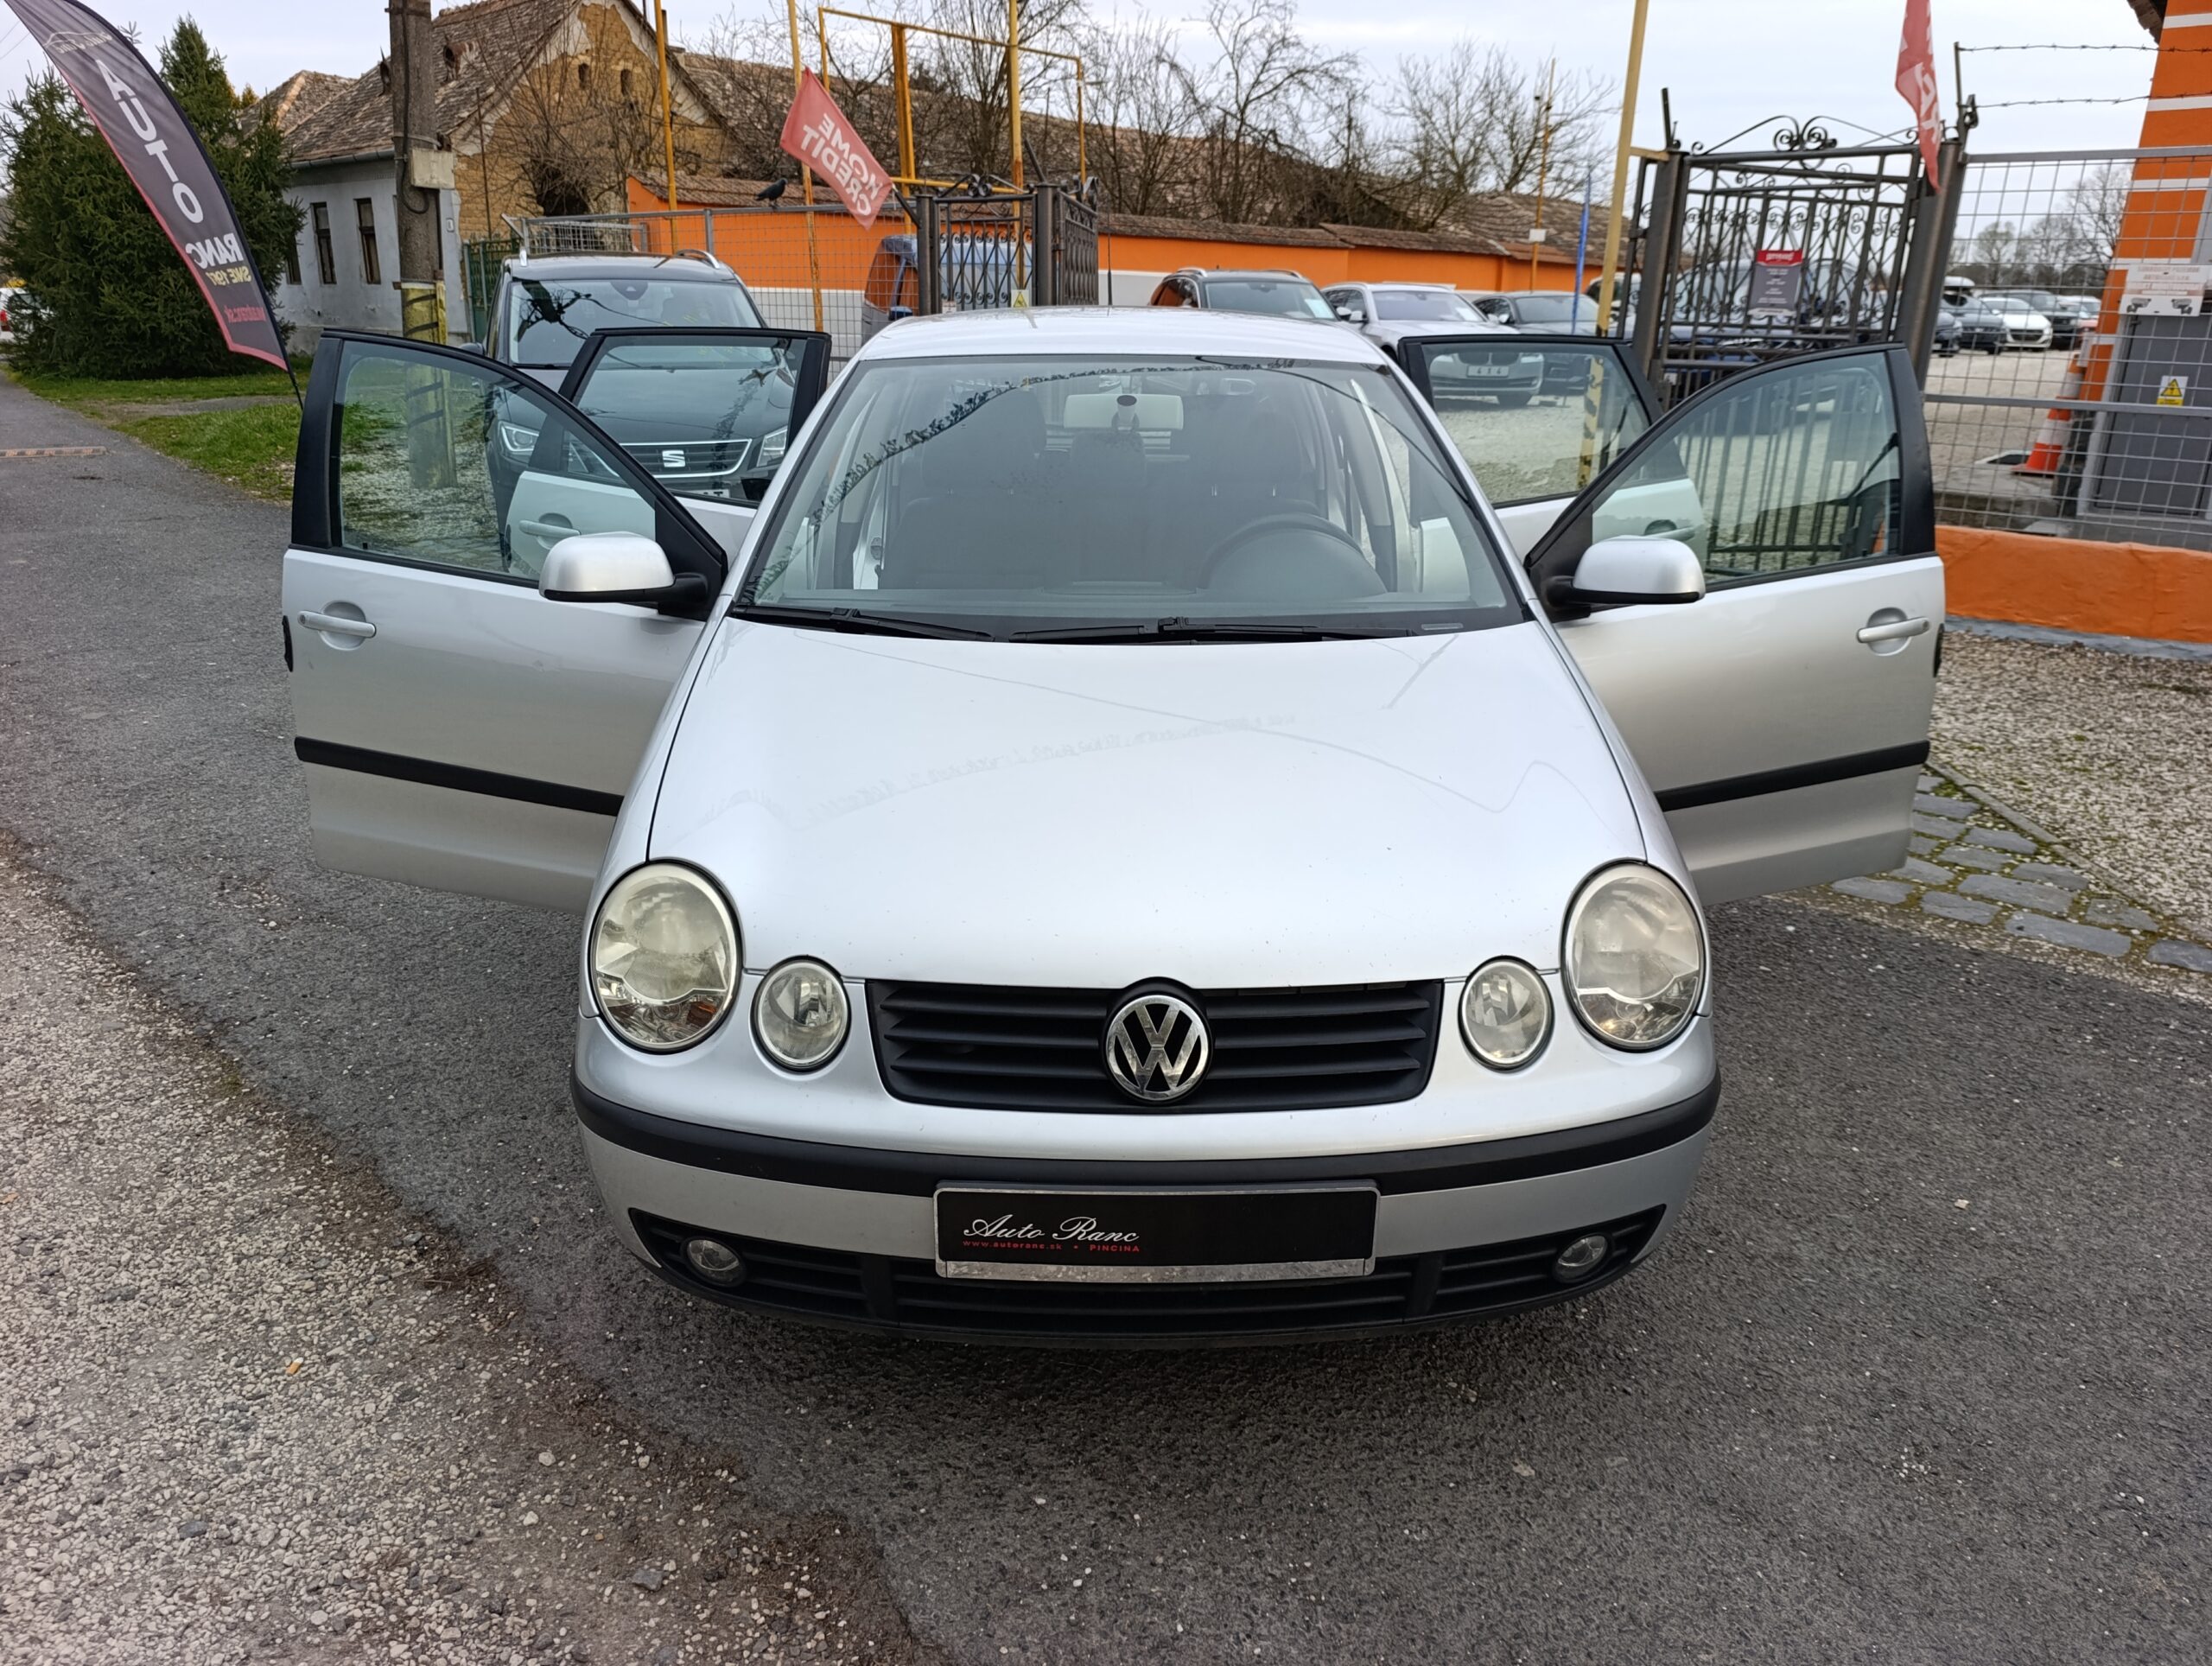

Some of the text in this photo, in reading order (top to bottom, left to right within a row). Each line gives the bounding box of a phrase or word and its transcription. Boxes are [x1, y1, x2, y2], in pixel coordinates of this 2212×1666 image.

[1107, 995, 1208, 1100] VW
[963, 1214, 1140, 1243] Auto Ranc
[962, 1240, 1140, 1252] www.autoranc.sk PINCINA
